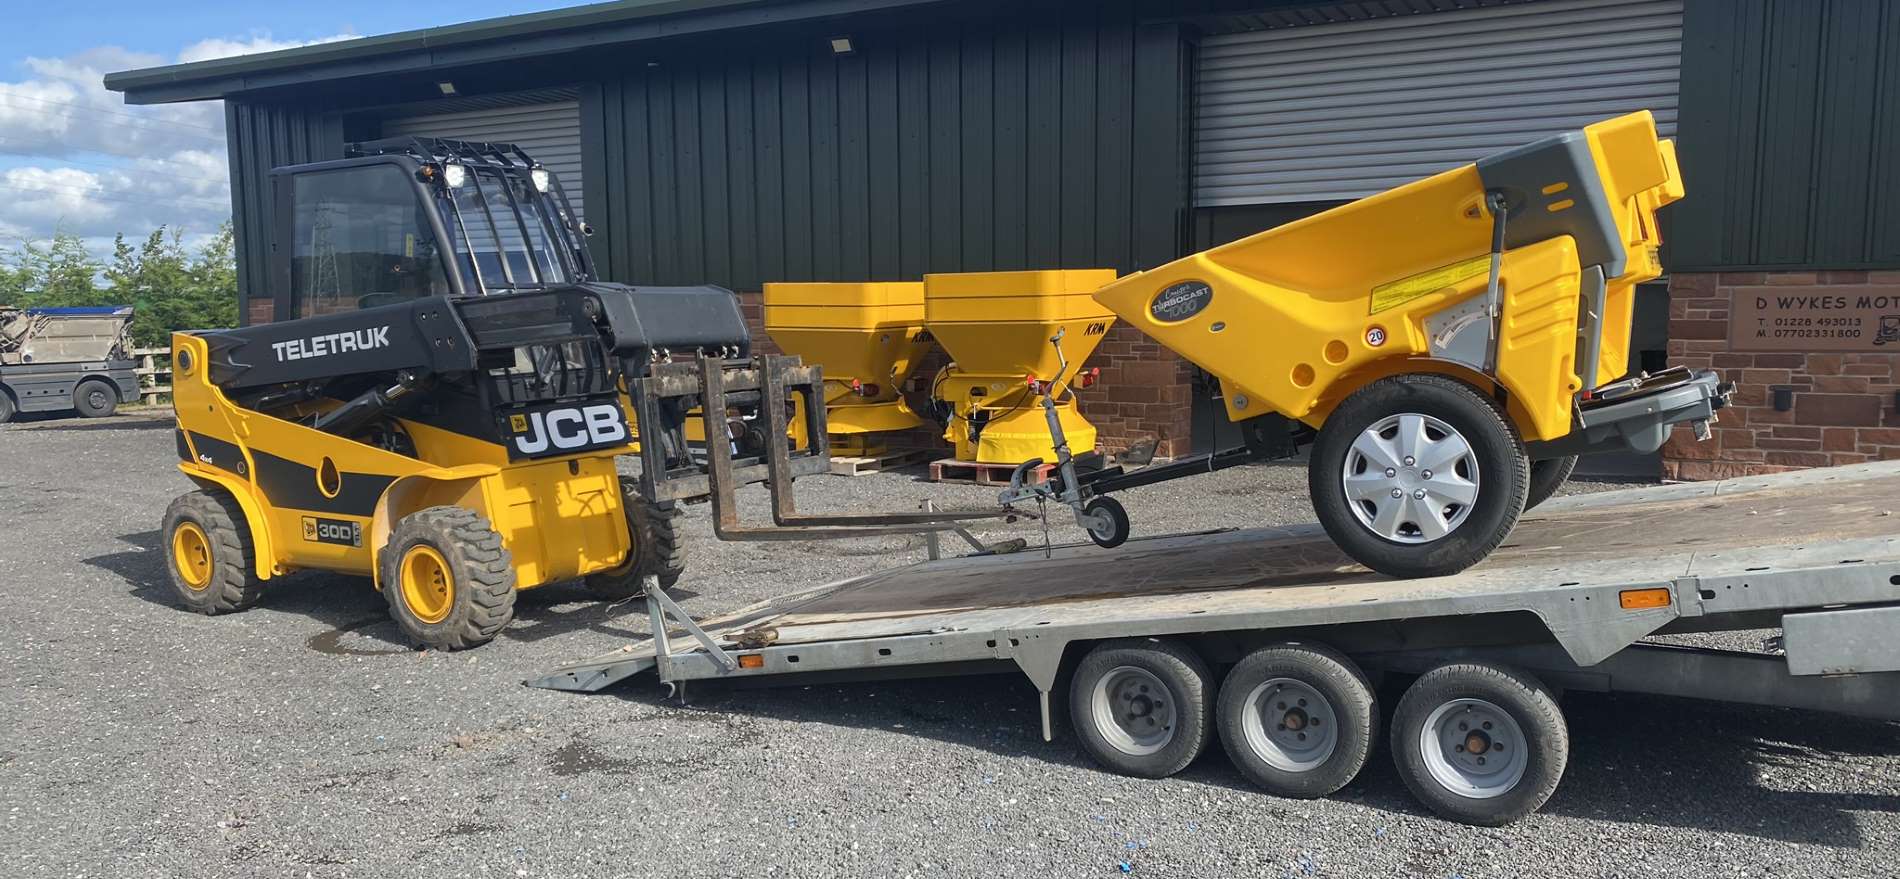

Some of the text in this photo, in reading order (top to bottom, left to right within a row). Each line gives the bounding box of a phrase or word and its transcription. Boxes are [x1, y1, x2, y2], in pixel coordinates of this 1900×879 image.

[1152, 287, 1209, 314] TURBOCAST
[1756, 297, 1768, 310] D
[1777, 296, 1847, 310] WYKES
[1084, 322, 1105, 336] KRM
[1775, 318, 1812, 327] 01228
[1817, 318, 1862, 327] 493013
[1369, 331, 1382, 342] 20
[1774, 329, 1861, 338] 07702331800
[271, 325, 390, 362] TELETRUK
[515, 404, 625, 454] JCB
[318, 524, 351, 540] 30D
